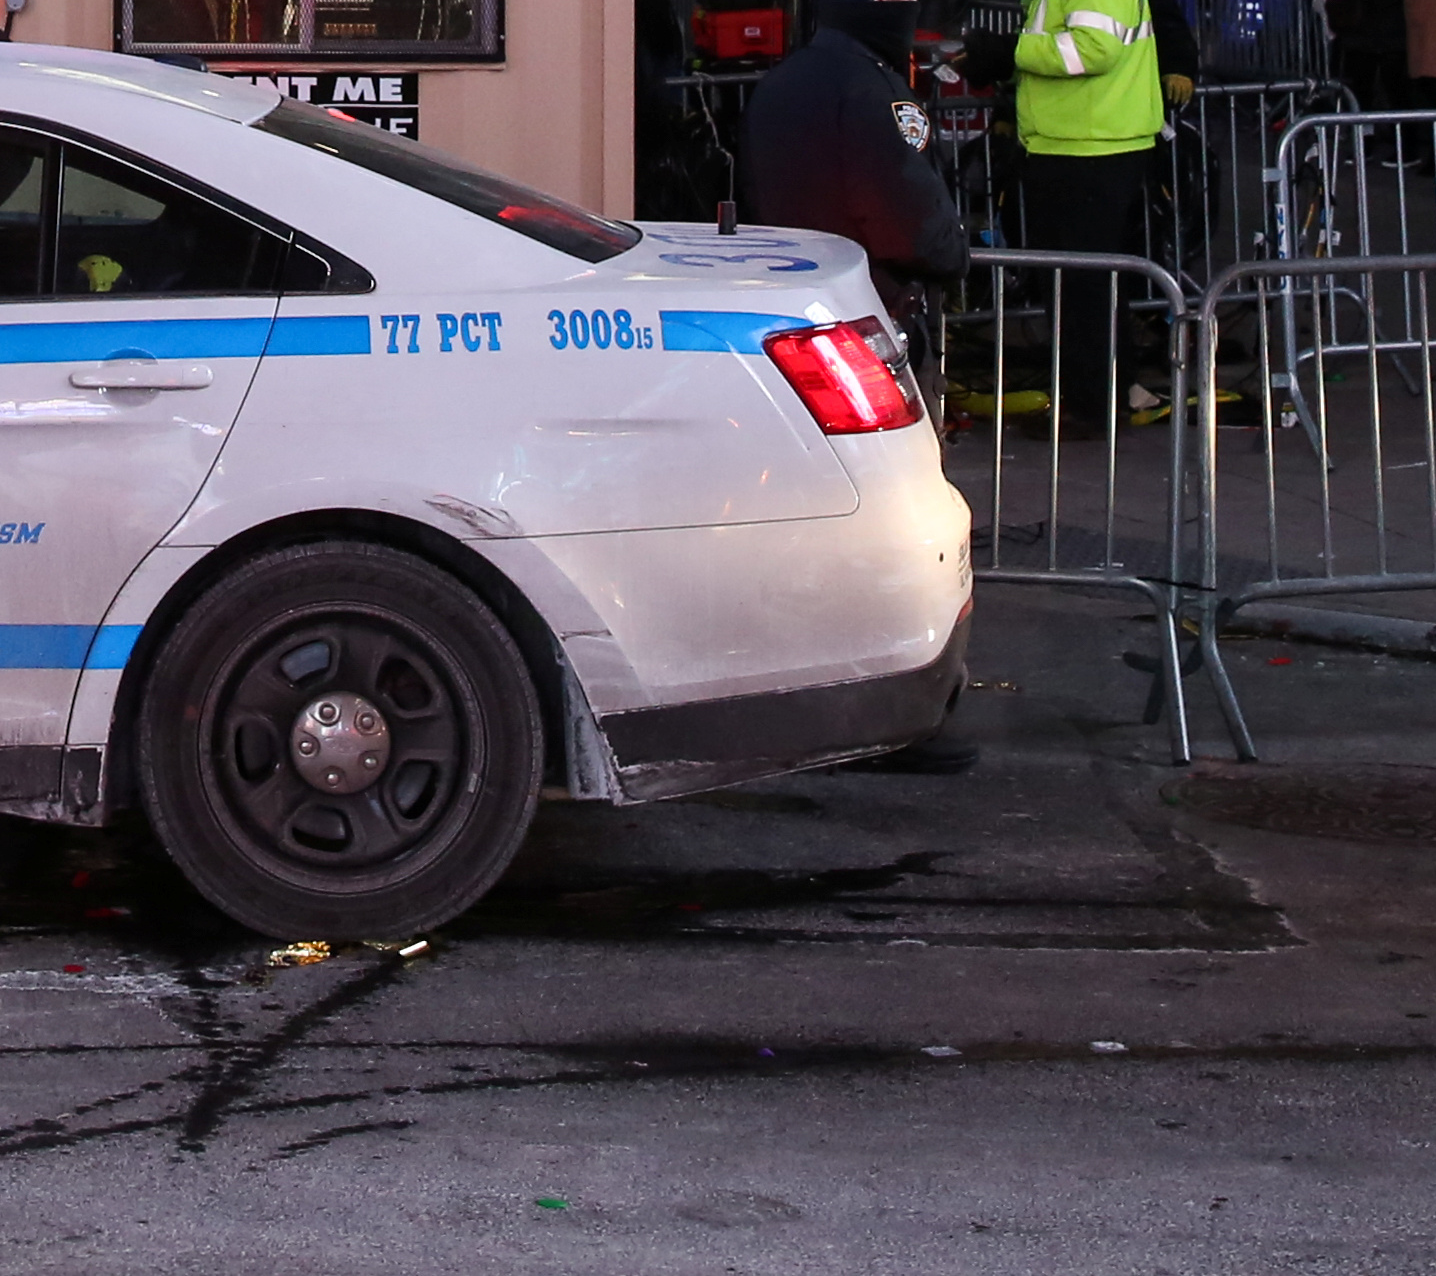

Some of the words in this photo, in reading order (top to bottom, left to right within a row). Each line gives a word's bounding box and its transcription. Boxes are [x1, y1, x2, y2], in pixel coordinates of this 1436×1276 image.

[233, 76, 318, 102] NT
[332, 76, 403, 103] ME
[380, 313, 425, 354] 77
[438, 312, 502, 352] PCT
